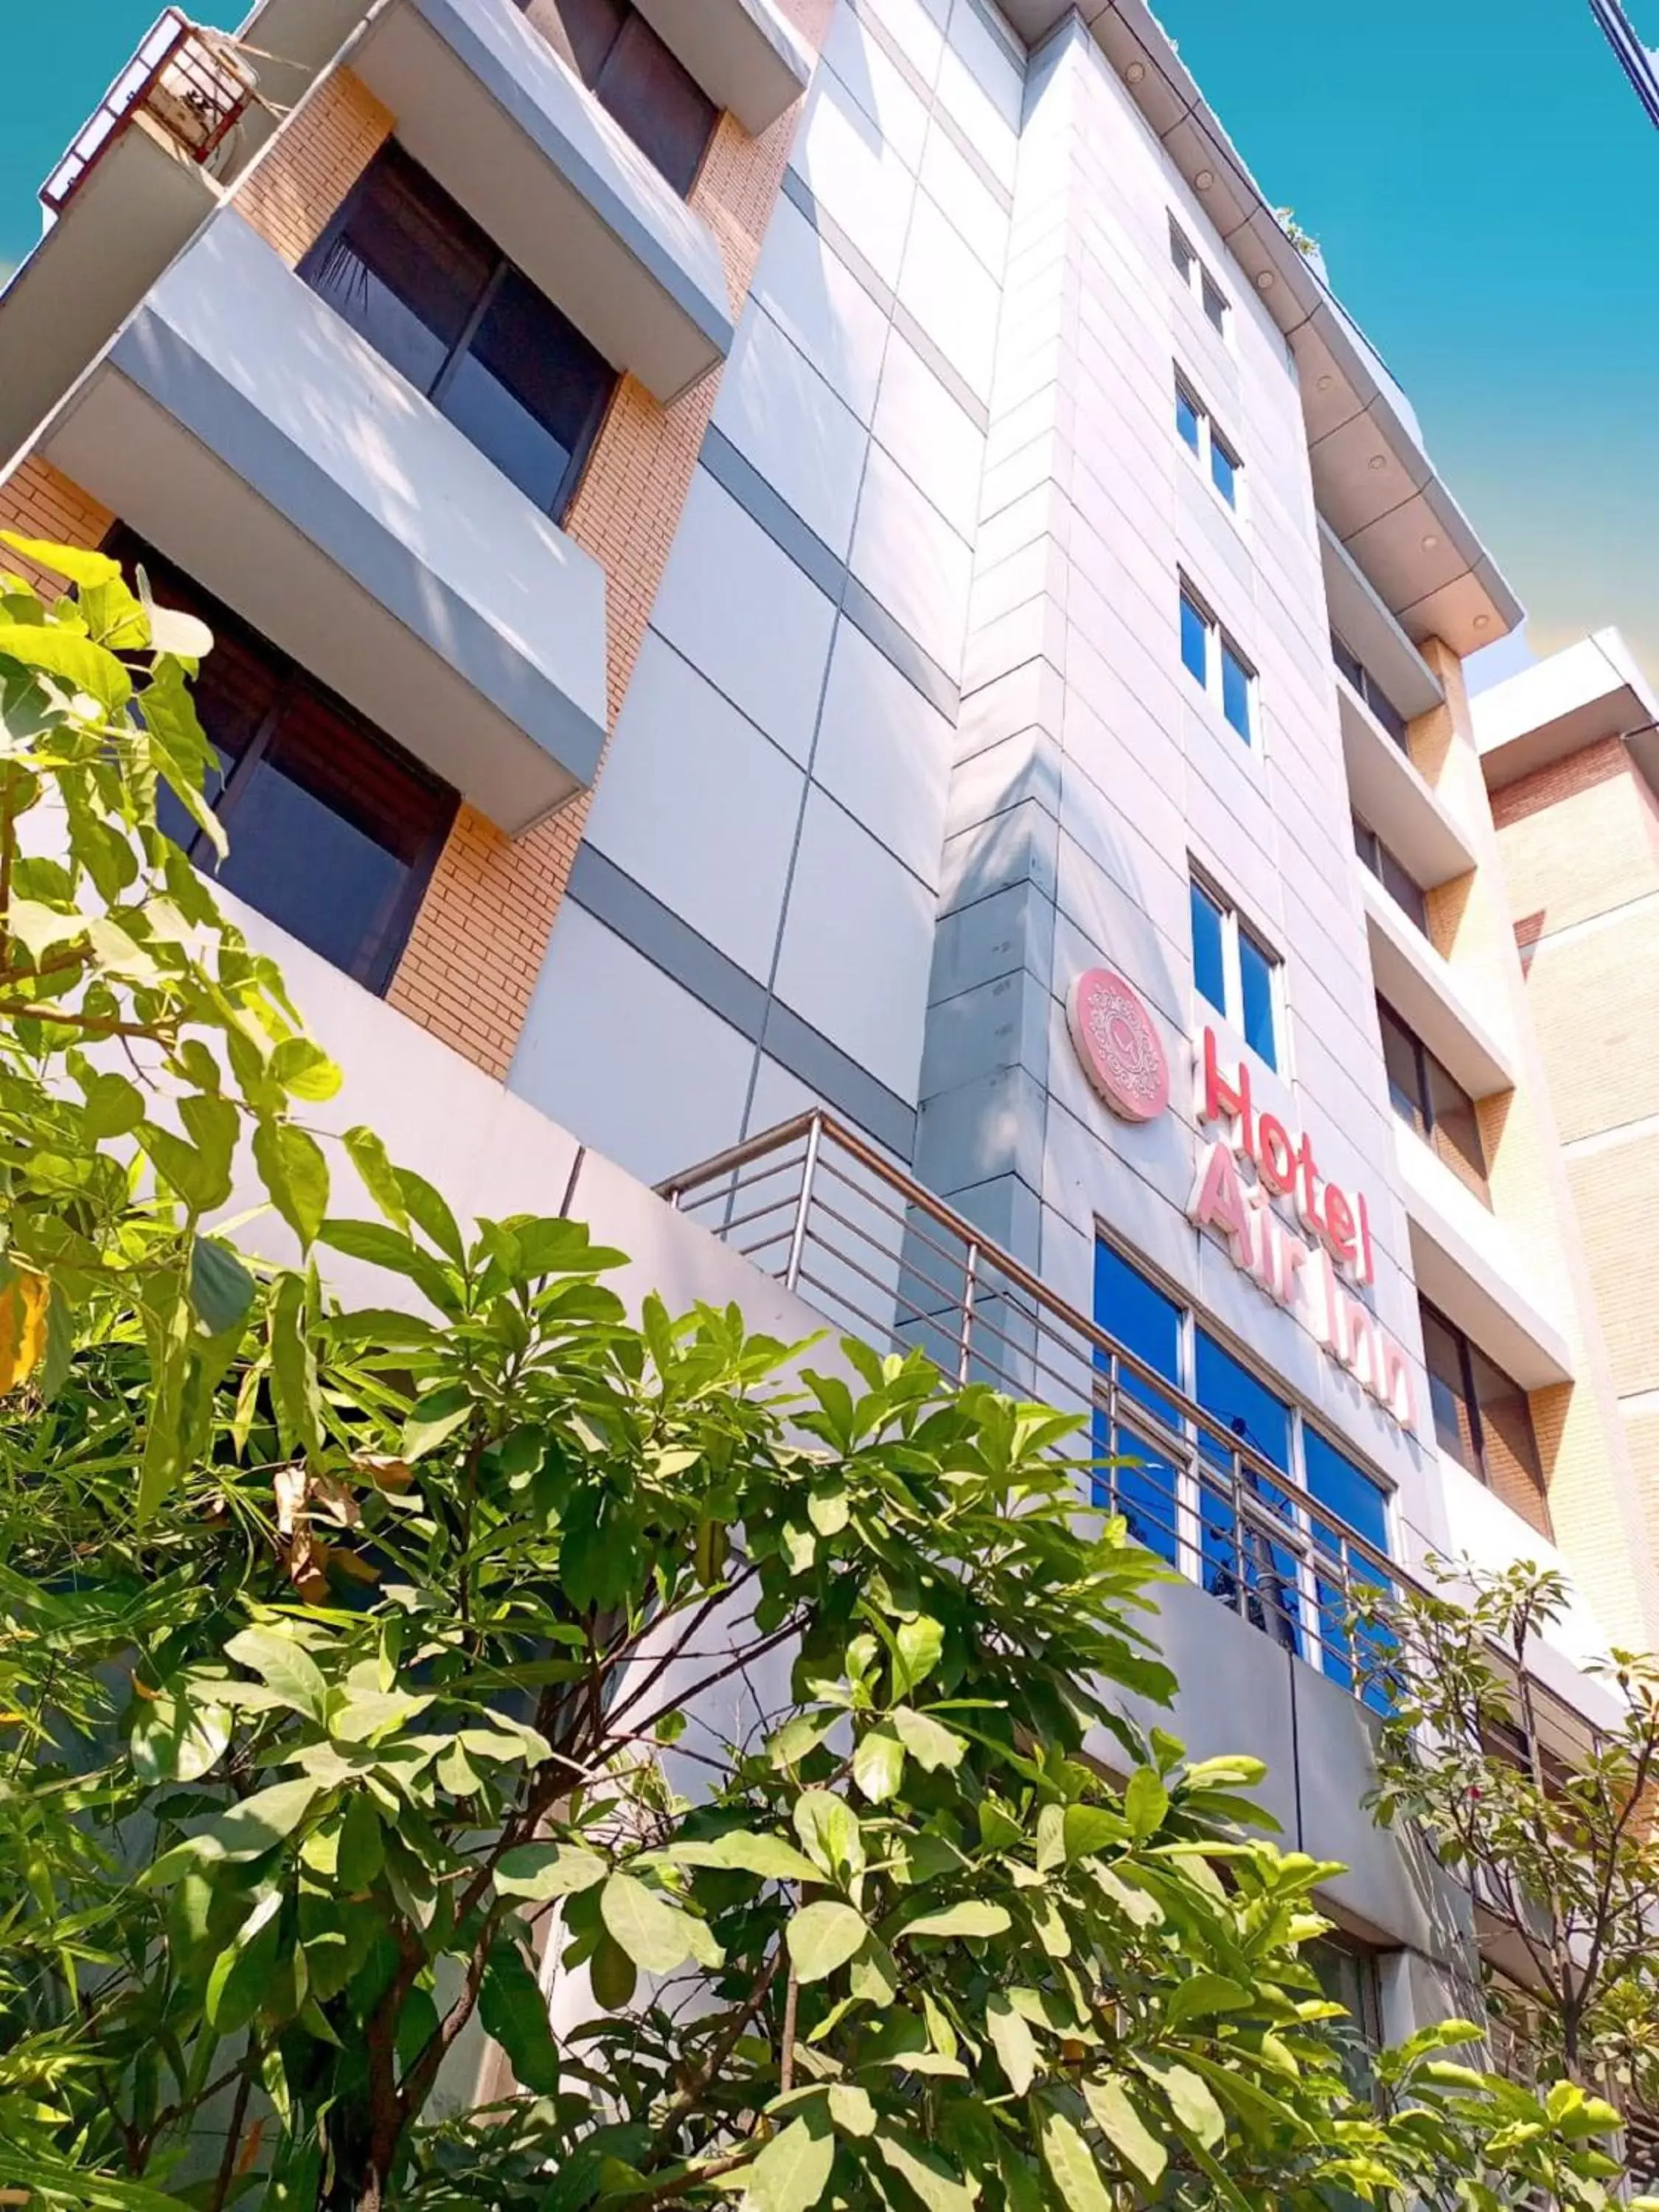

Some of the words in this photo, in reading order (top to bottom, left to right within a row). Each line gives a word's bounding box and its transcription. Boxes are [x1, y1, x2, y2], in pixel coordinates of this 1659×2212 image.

[1189, 1138, 1306, 1305] Air
[1310, 1248, 1418, 1430] Inn
[1199, 1025, 1374, 1287] Hotel
